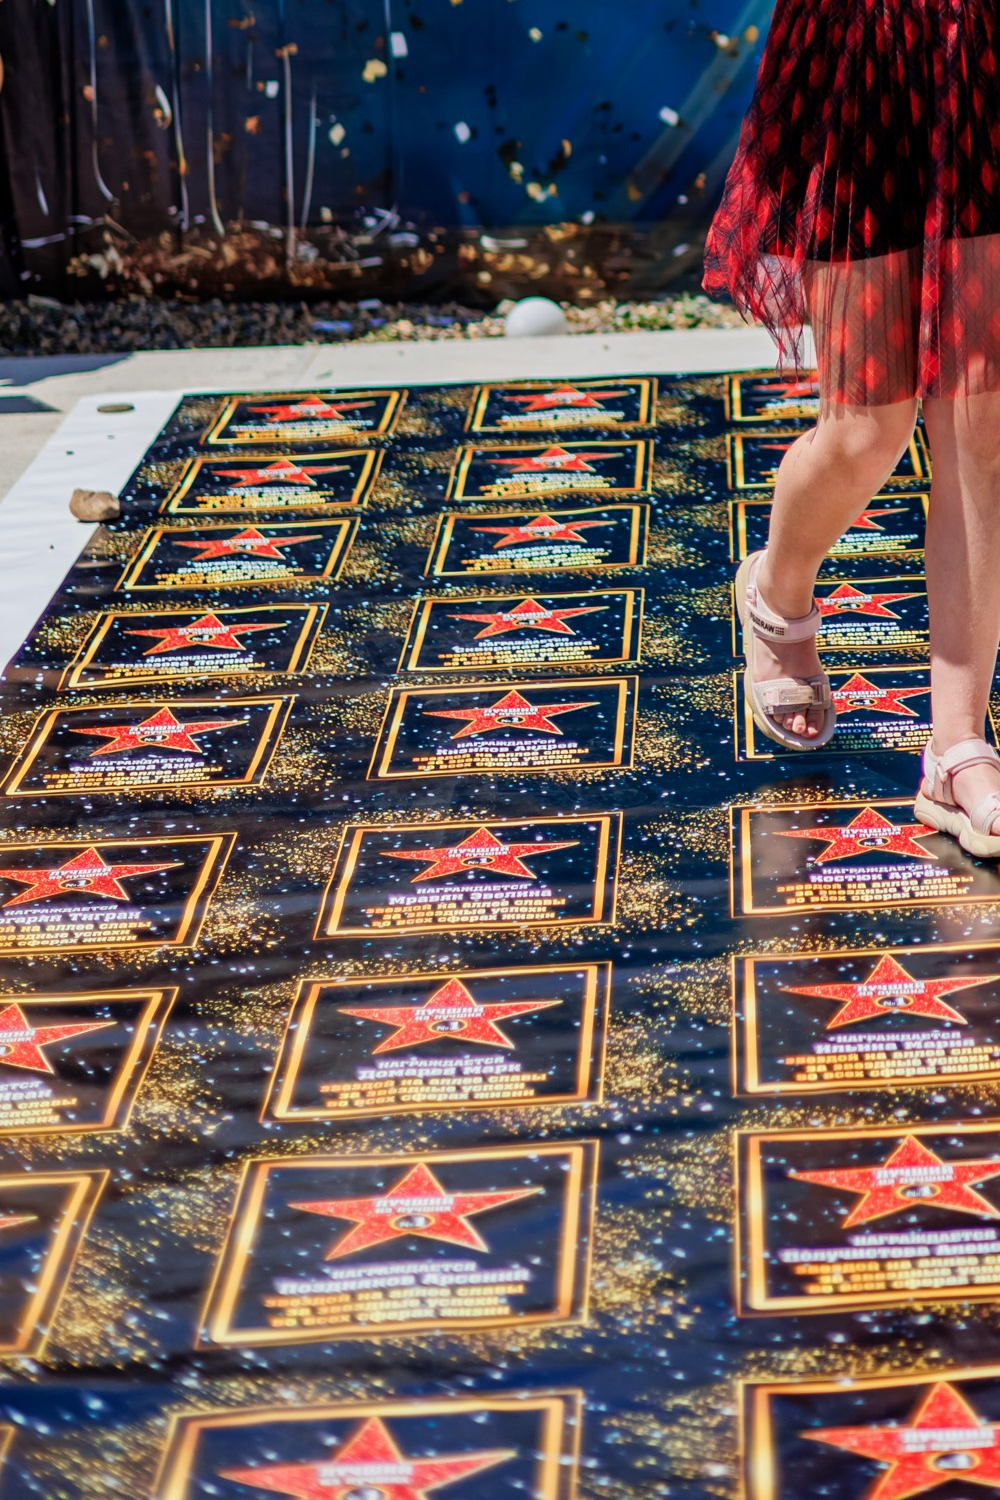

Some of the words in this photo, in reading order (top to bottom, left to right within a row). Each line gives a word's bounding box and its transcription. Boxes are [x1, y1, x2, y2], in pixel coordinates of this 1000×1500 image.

[810, 874, 882, 883] Костюк
[471, 889, 552, 900] Эвелина
[5, 905, 118, 916] НАГРАЖДАЕТСЯ
[69, 912, 142, 922] Тигран
[463, 1063, 521, 1076] Марк
